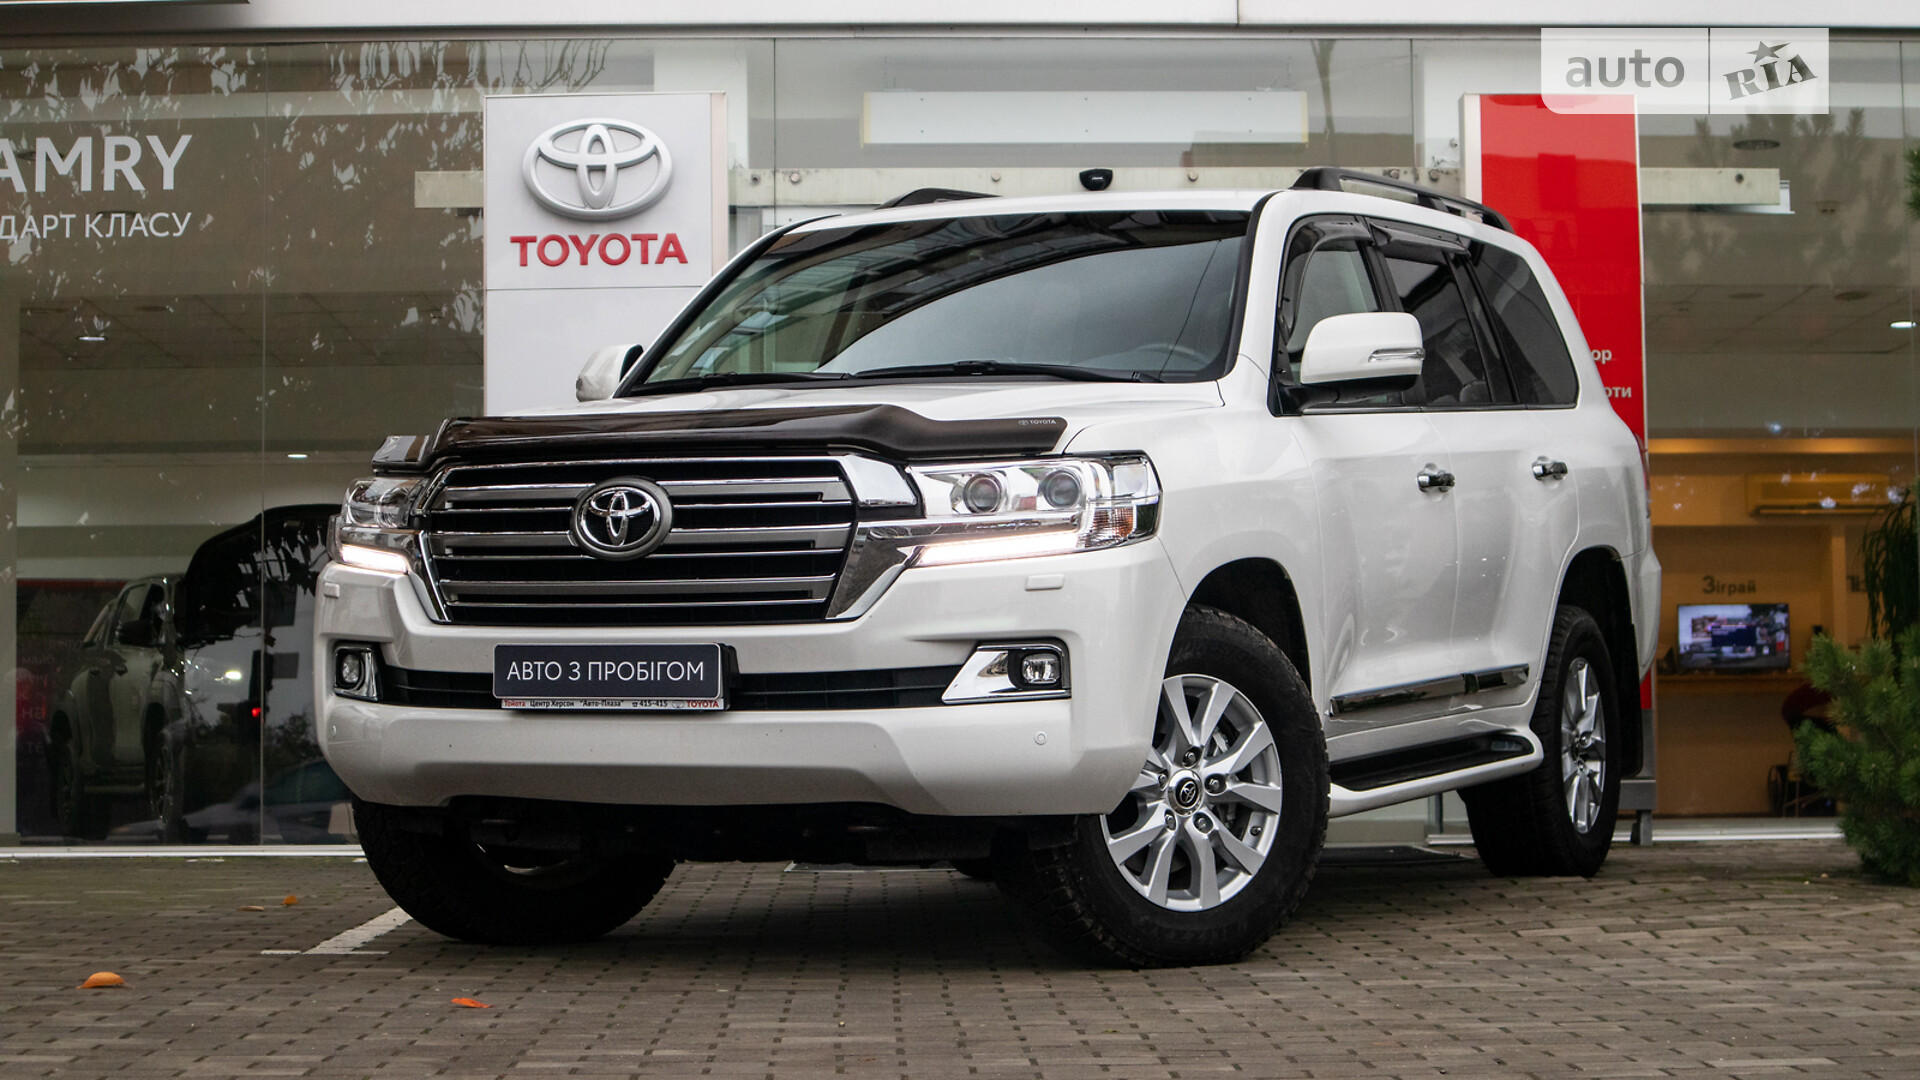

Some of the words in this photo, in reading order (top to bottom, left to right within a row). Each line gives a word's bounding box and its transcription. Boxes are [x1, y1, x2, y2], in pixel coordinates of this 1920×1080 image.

[84, 211, 192, 238] КЛАСУ
[509, 232, 689, 268] TOYOTA
[506, 661, 563, 681] АВТО
[588, 661, 705, 681] ПРОБІГОМ
[529, 700, 550, 709] Центр
[551, 700, 575, 709] Херсон
[686, 700, 720, 708] TOYOTA
